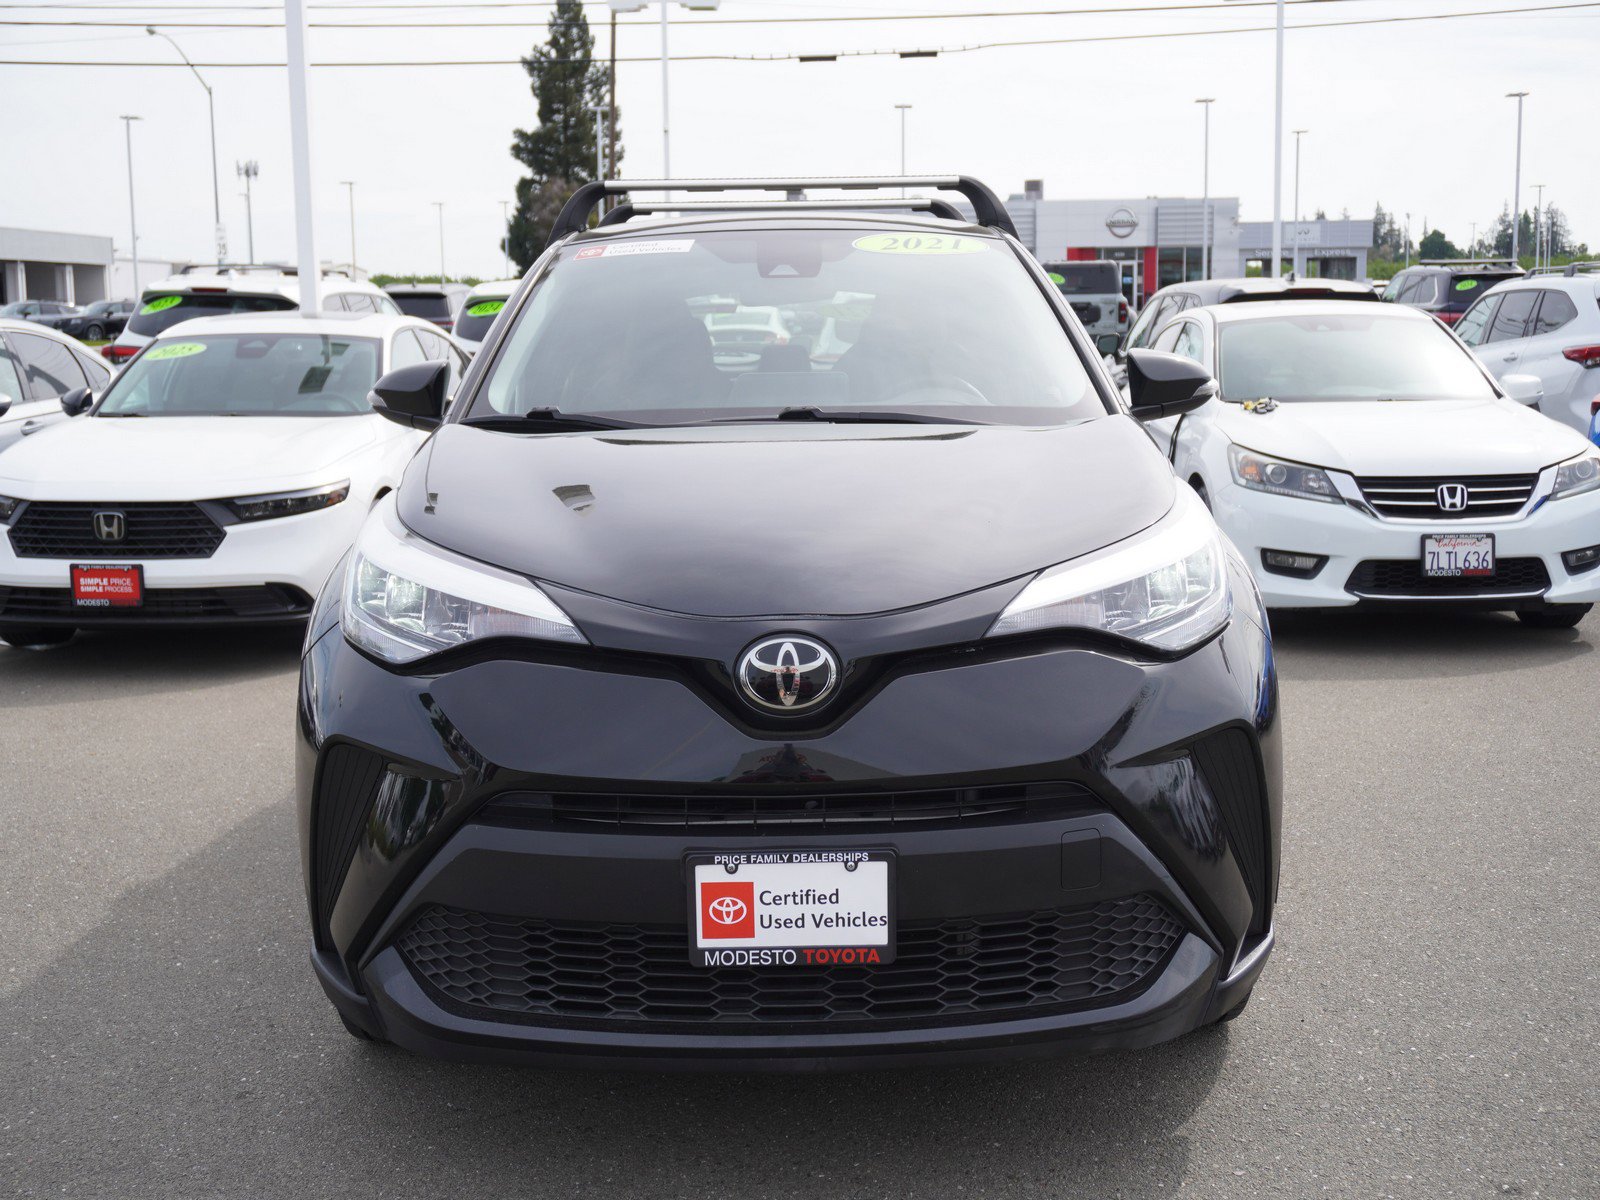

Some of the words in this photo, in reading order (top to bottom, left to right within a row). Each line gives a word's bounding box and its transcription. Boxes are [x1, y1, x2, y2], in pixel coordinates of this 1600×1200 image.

[879, 237, 963, 250] 2021
[1437, 538, 1480, 549] California
[1427, 550, 1490, 570] 7LTL636
[1427, 569, 1461, 577] MODESTO
[80, 578, 108, 586] SIMPLE
[76, 599, 110, 607] MODESTO
[714, 855, 747, 865] PRICE
[750, 854, 789, 864] FAMILY
[792, 852, 869, 863] DEALERSHIPS
[759, 888, 840, 906] Certified
[759, 912, 805, 929] Used
[810, 911, 888, 928] Vehicles
[704, 949, 797, 966] MODESTO
[803, 948, 881, 964] TOYOTA
